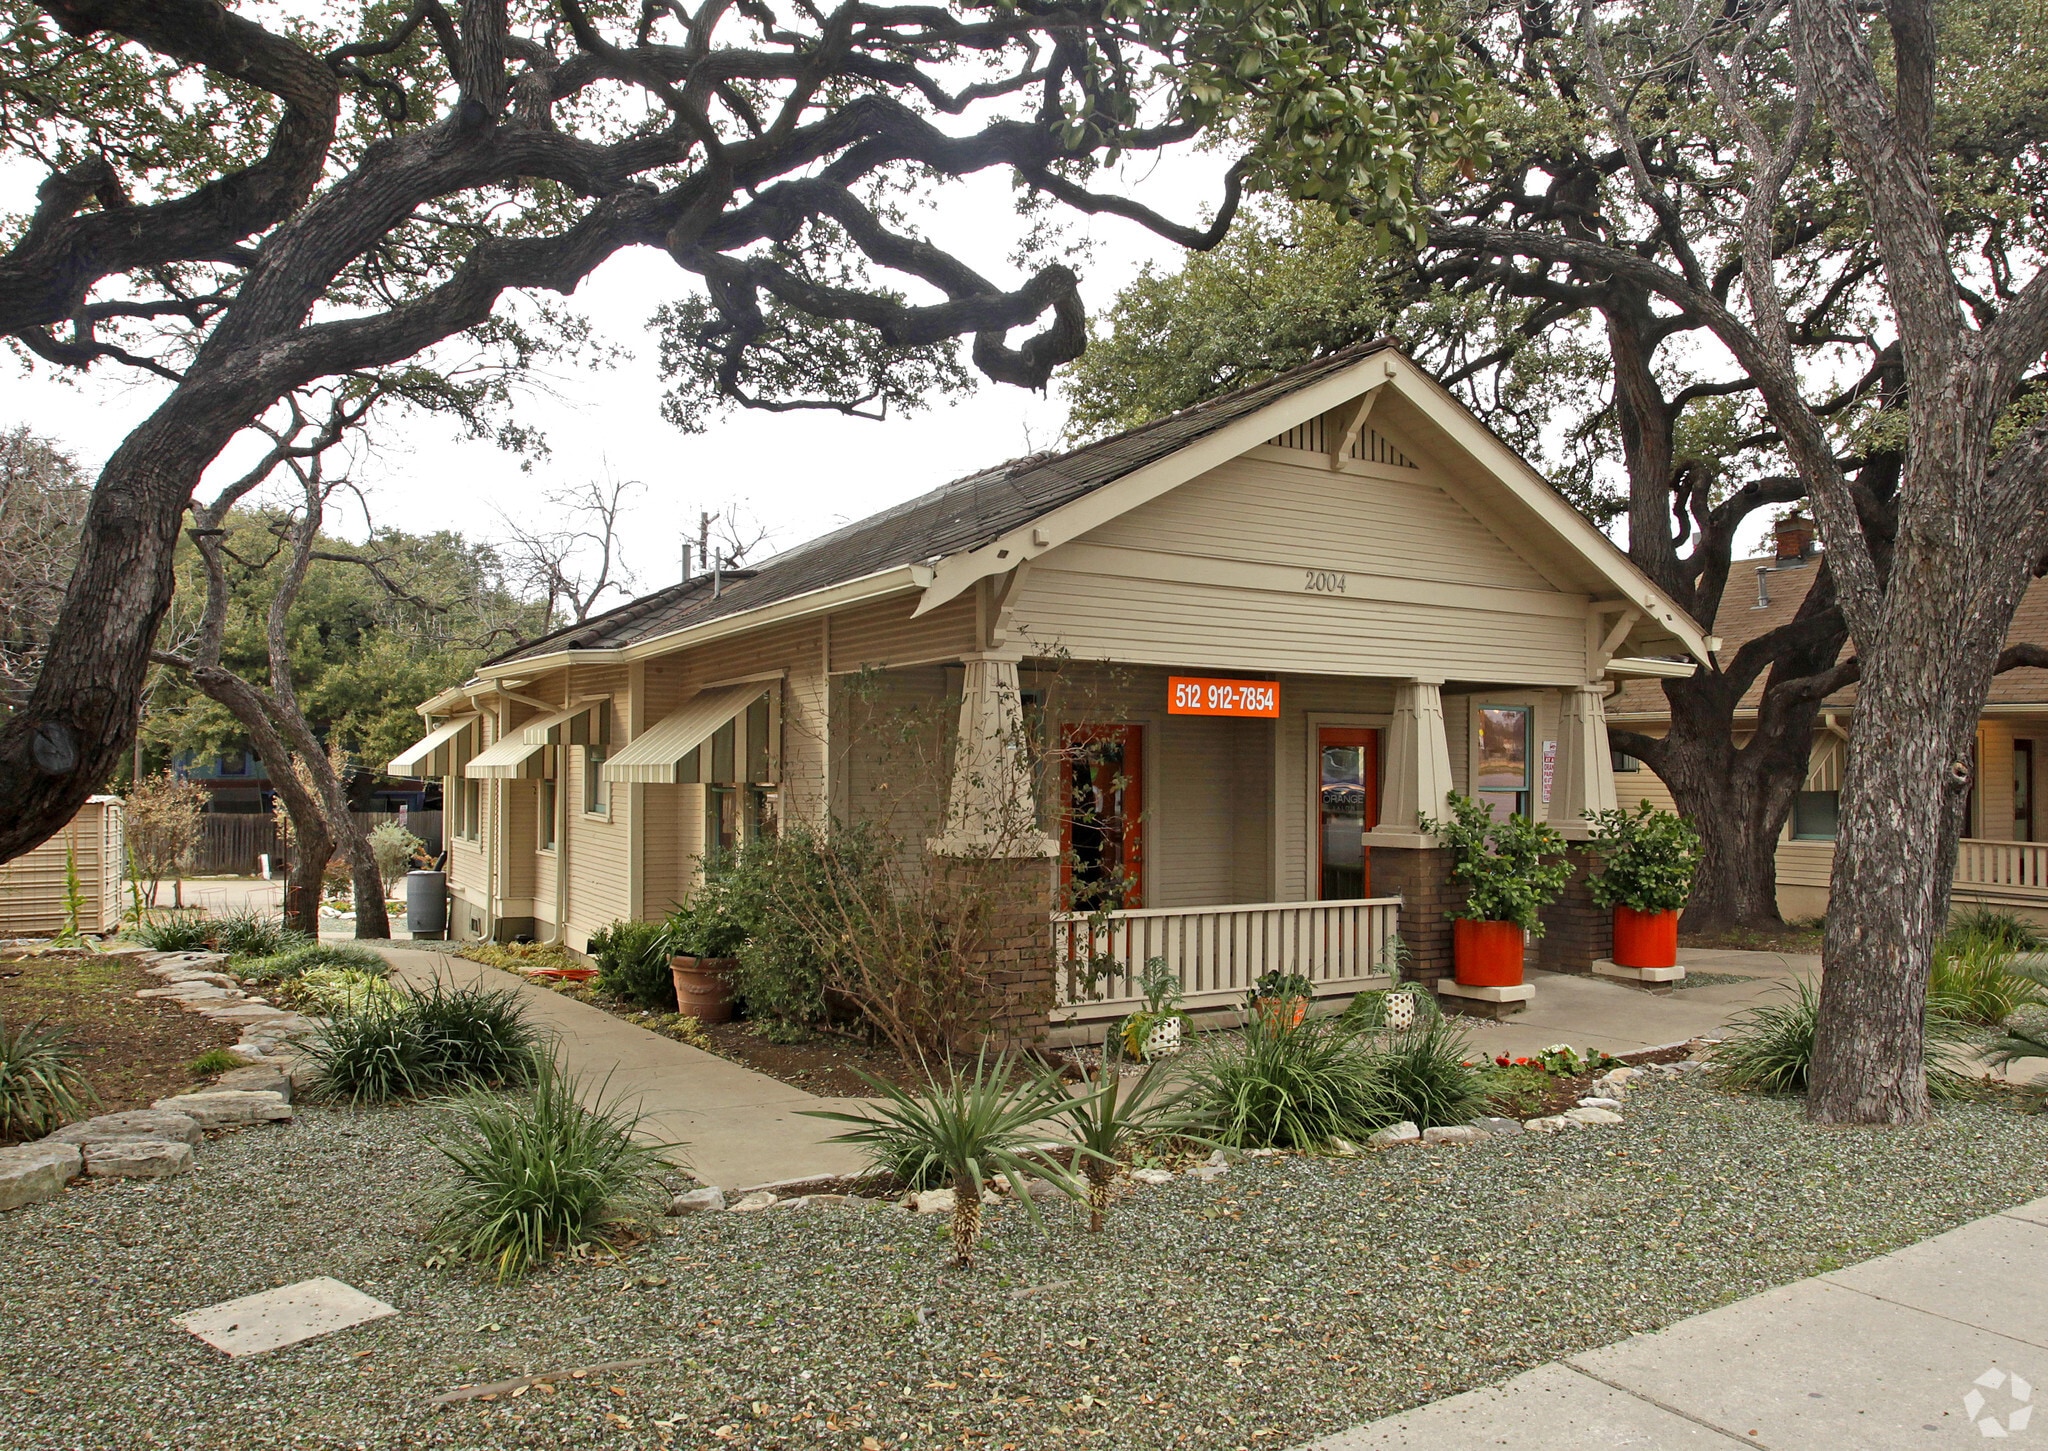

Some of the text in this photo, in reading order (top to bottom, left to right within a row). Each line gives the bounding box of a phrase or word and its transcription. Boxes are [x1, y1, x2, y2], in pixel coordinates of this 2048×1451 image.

[1304, 569, 1346, 593] 2004
[1175, 684, 1274, 711] 512 912-7854
[1323, 794, 1364, 804] ORANGE
